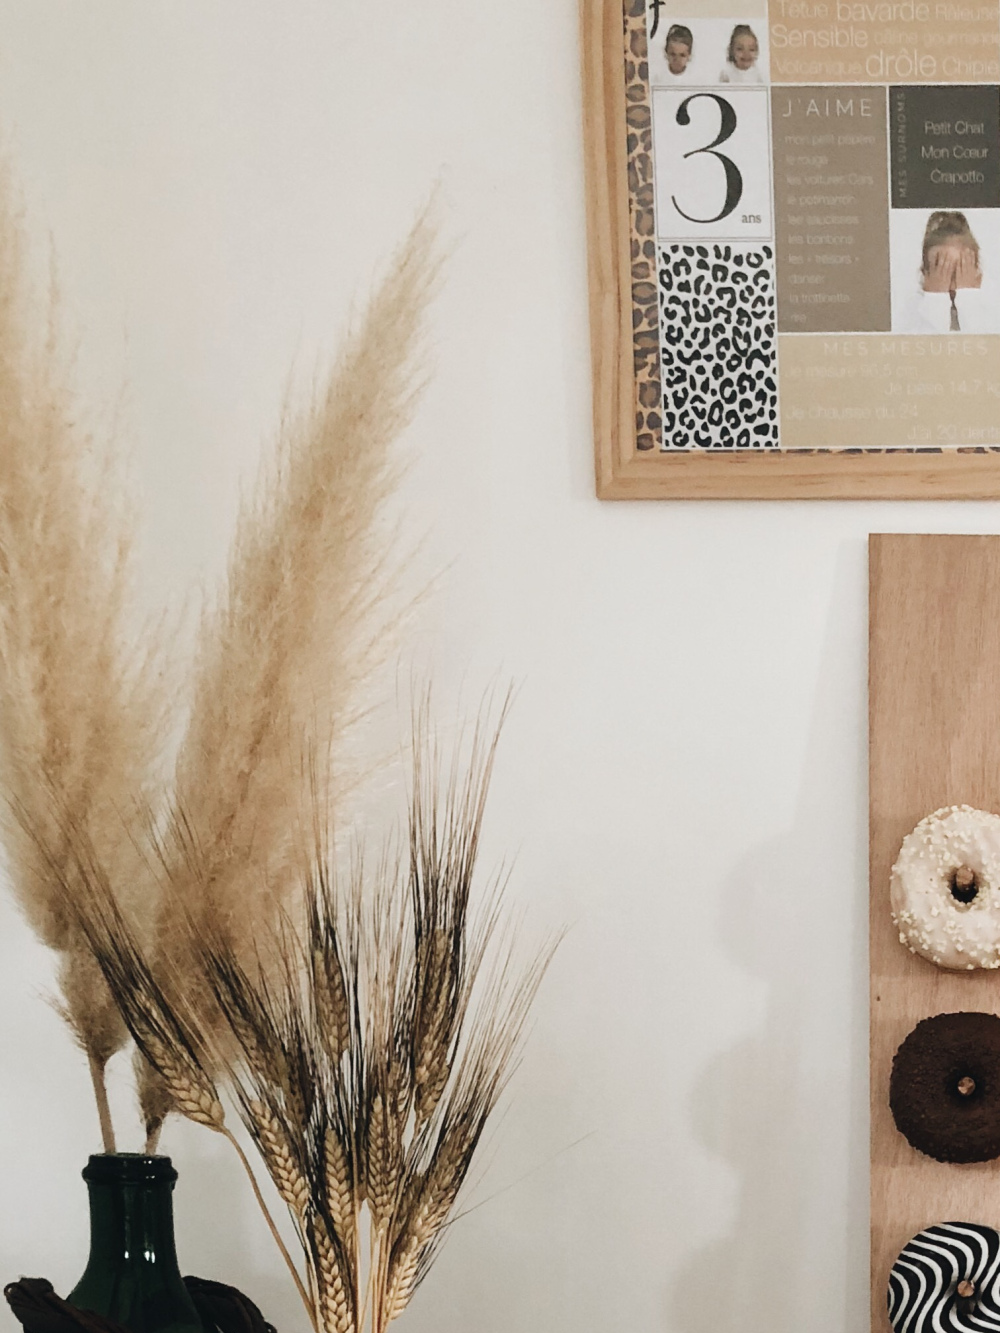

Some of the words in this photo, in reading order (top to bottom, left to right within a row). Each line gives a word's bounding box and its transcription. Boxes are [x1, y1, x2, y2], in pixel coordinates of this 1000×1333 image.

[836, 0, 930, 21] bavarde
[771, 24, 868, 48] Sensible
[865, 48, 937, 77] drôle
[782, 98, 873, 118] J'AIME
[924, 120, 951, 135] Petit
[955, 120, 985, 135] Chat
[671, 93, 743, 223] 3
[921, 145, 949, 159] Mon
[741, 213, 761, 224] ans
